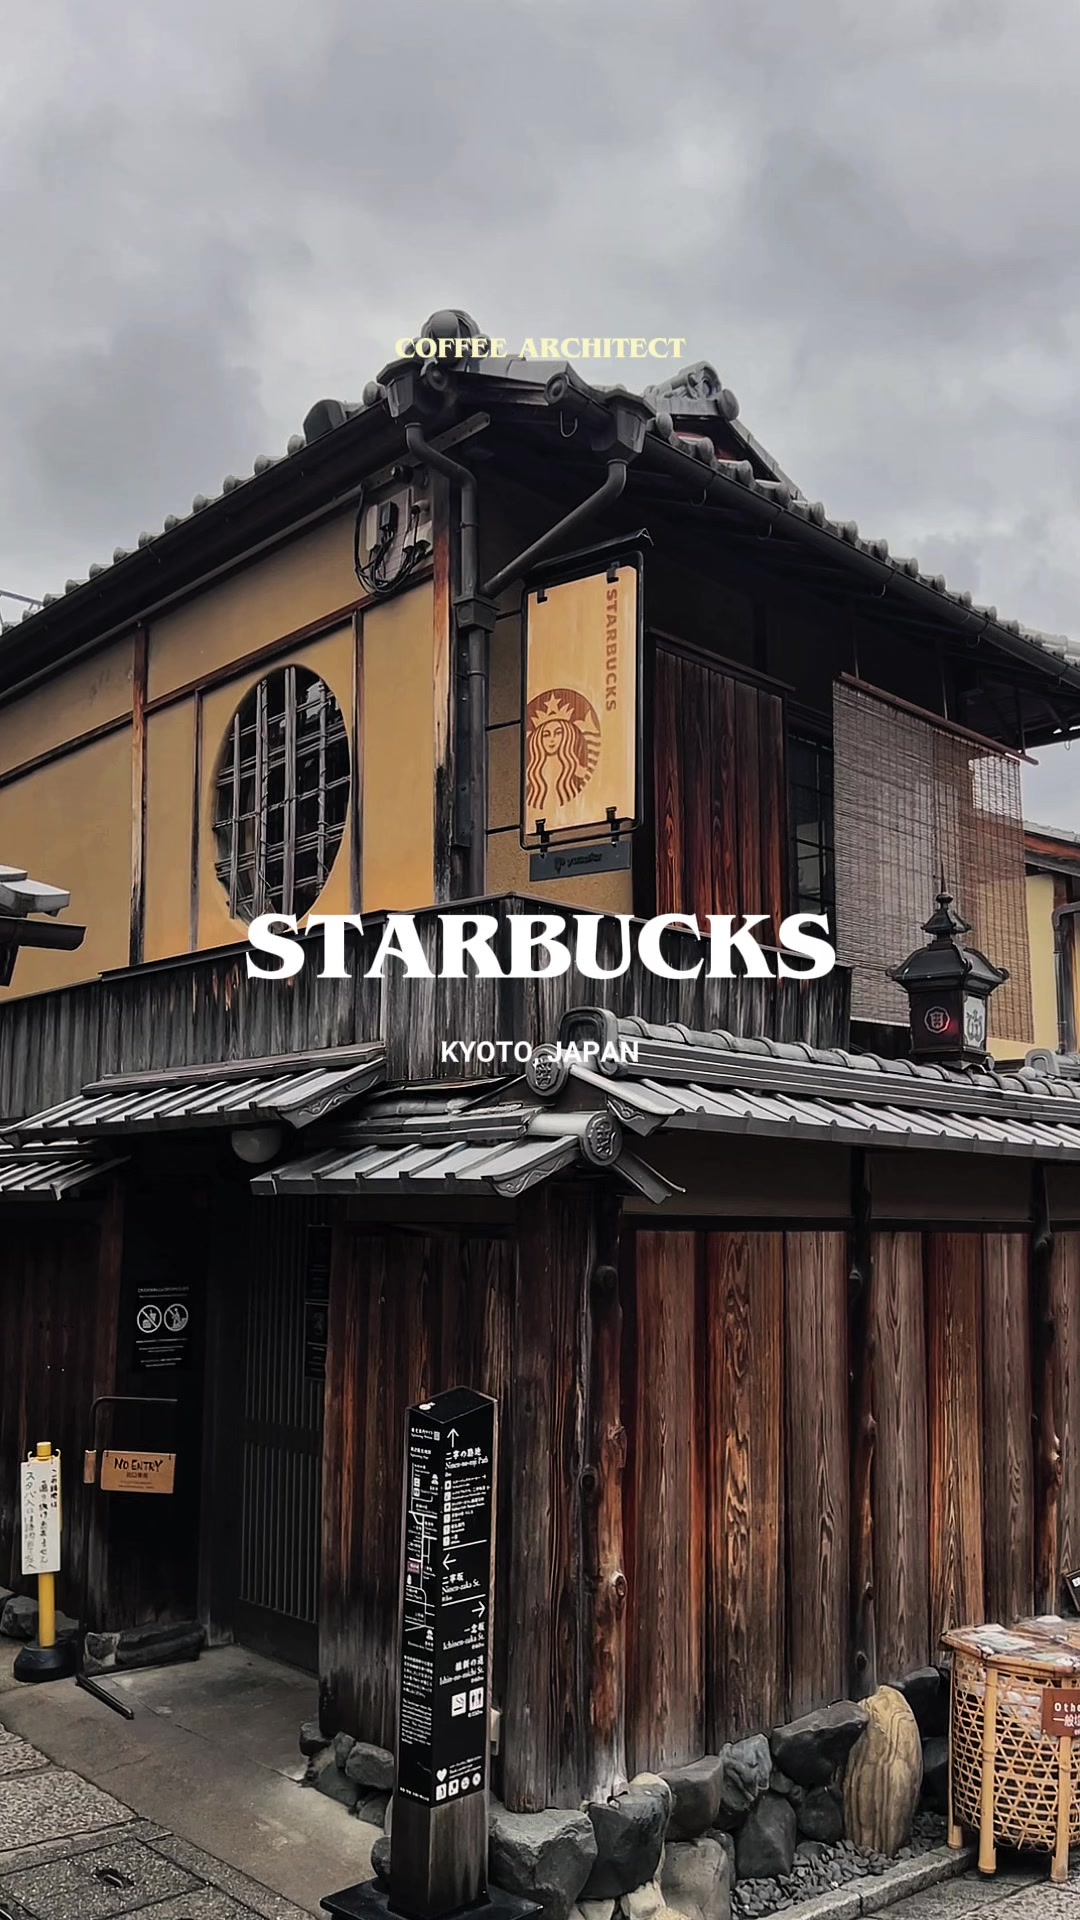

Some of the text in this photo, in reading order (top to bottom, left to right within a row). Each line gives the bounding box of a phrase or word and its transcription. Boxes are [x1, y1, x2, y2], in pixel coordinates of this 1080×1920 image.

[605, 587, 619, 712] STARBUCKS
[114, 1457, 164, 1473] NO ENTRY
